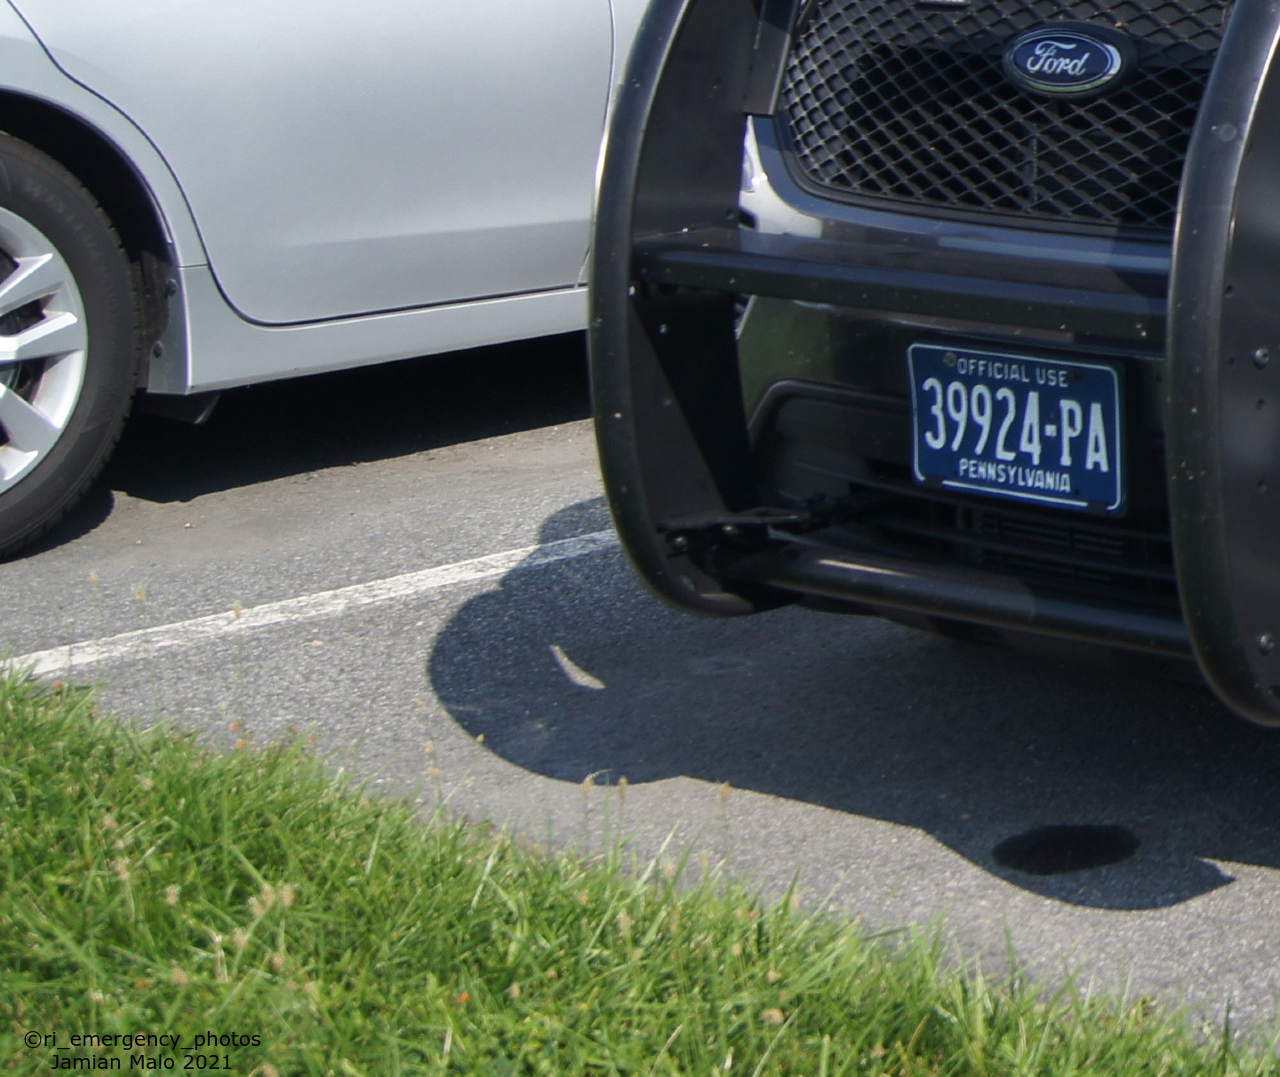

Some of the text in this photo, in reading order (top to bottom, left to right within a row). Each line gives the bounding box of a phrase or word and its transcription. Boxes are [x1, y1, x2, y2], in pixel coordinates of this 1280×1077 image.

[1026, 39, 1092, 77] Ford
[957, 358, 1068, 388] OFFICIAL USE
[922, 377, 1109, 472] 39924-PA
[959, 458, 1071, 492] PENNSYLVANIA
